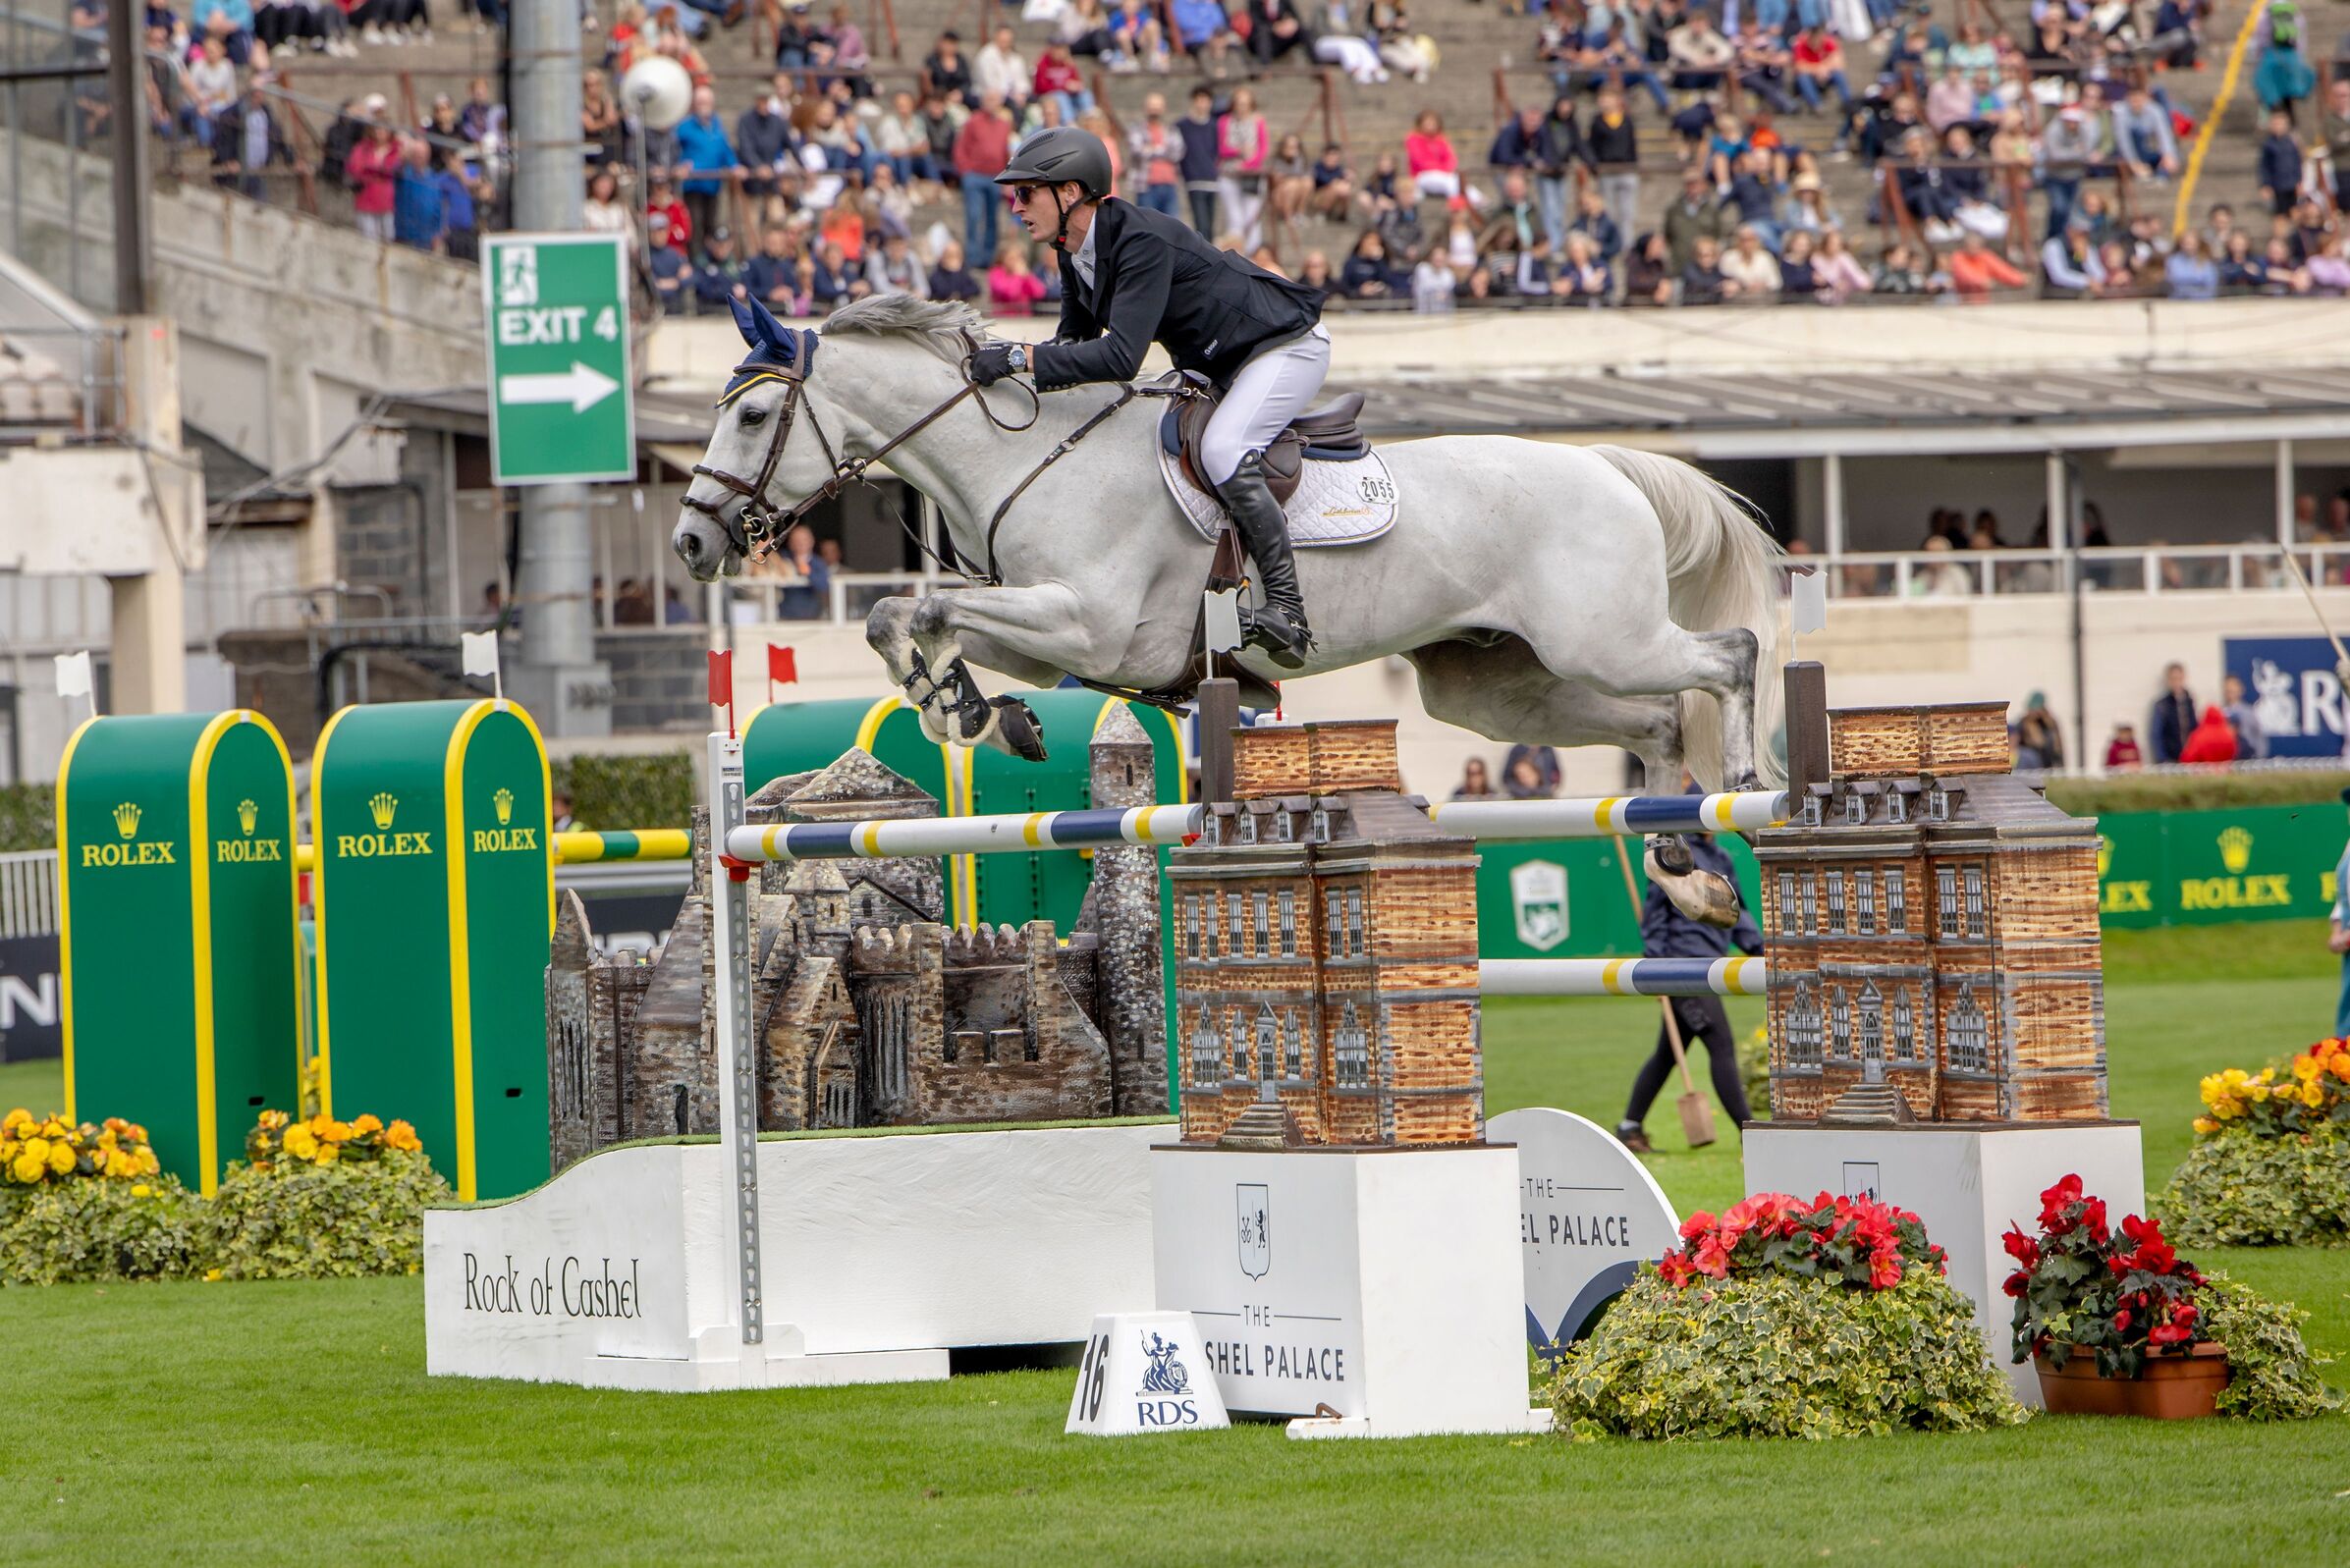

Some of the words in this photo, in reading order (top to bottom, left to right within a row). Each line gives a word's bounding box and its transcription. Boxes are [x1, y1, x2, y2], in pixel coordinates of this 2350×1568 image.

[499, 305, 587, 345] EXIT
[593, 304, 619, 342] 4
[1361, 481, 1394, 499] 2055
[216, 839, 282, 862] ROLEX
[337, 832, 433, 857] ROLEX
[472, 828, 537, 852] ROLEX
[82, 841, 176, 867] ROLEX
[2180, 874, 2292, 910] ROLEX
[1526, 1178, 1554, 1198] THE
[1549, 1214, 1629, 1247] PALACE
[464, 1253, 522, 1314] Rock
[530, 1257, 553, 1316] of
[562, 1256, 641, 1319] Cashel
[1243, 1305, 1271, 1326] THE
[1265, 1345, 1344, 1381] PALACE
[1078, 1334, 1110, 1422] 16
[1137, 1400, 1198, 1426] RDS
